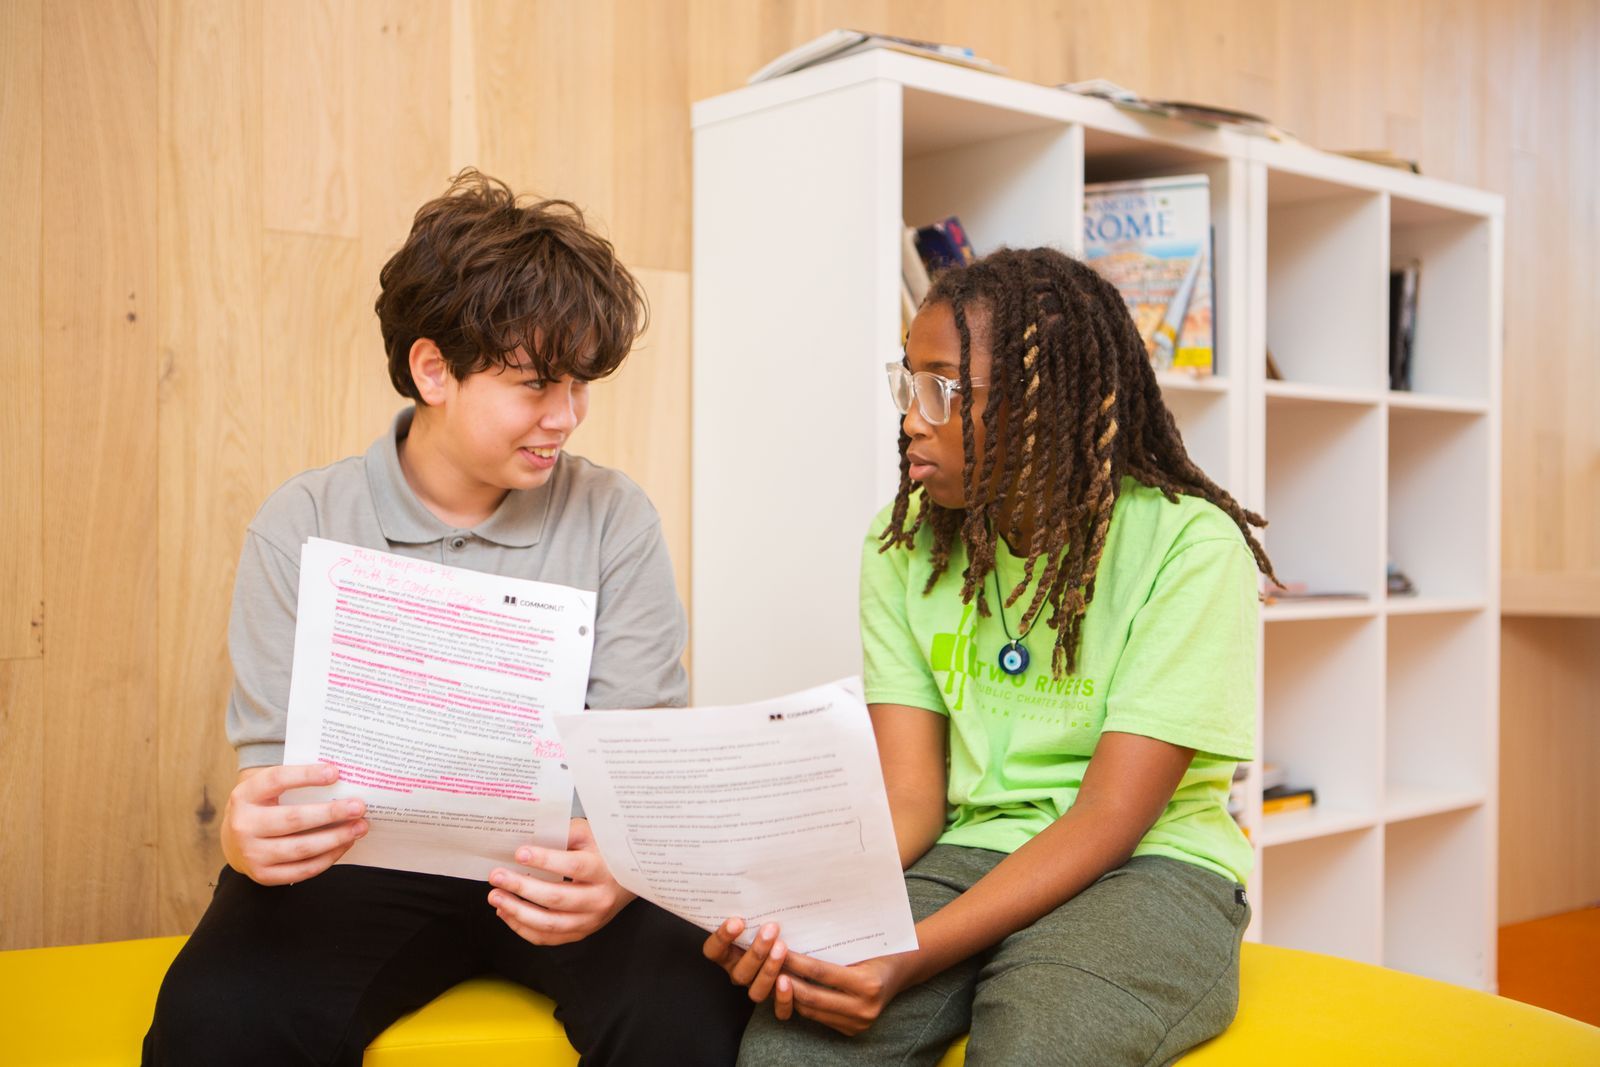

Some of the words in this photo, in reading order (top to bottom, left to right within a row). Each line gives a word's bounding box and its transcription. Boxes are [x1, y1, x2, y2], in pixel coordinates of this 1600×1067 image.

[1084, 212, 1175, 241] ROME
[519, 599, 565, 613] COMMONLIT
[976, 661, 1026, 688] TWO
[1036, 676, 1095, 697] RIVERS
[1017, 694, 1058, 708] CHARTER
